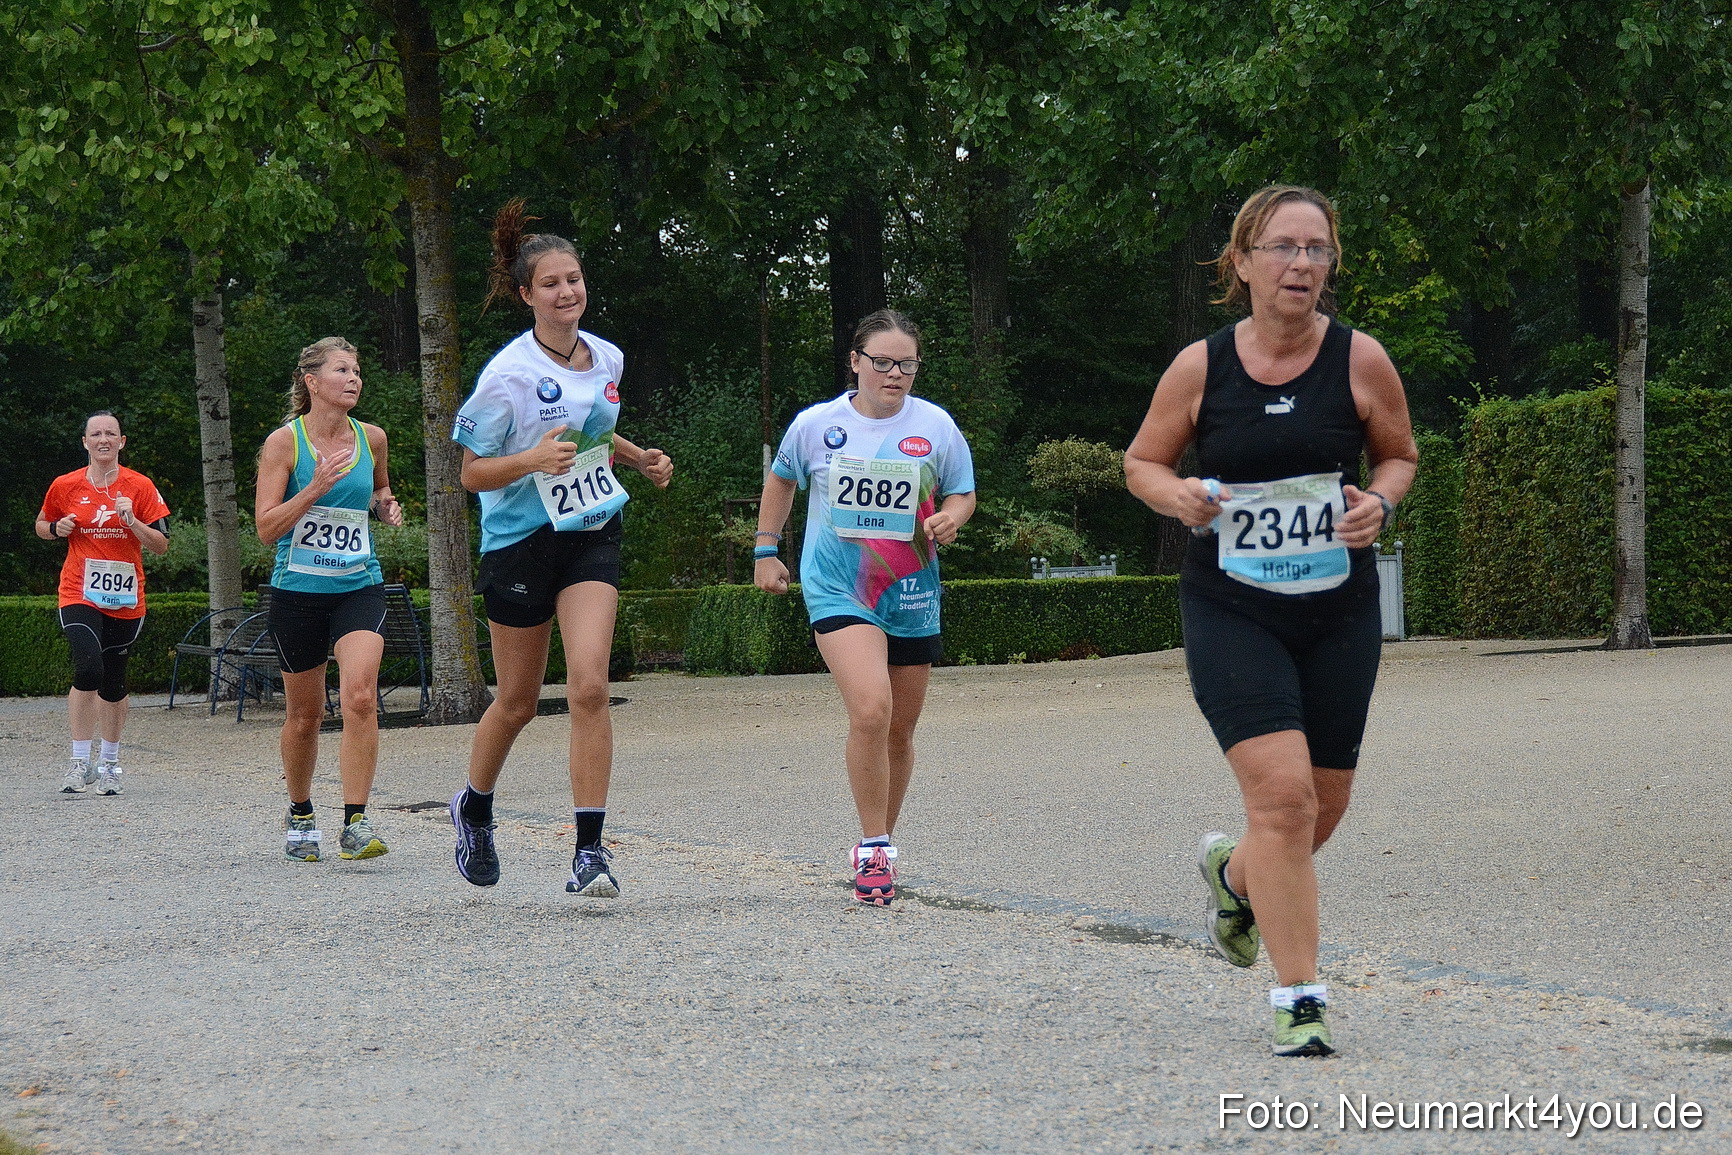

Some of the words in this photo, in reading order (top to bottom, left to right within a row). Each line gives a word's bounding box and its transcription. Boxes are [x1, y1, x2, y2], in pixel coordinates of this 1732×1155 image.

[539, 406, 568, 416] PARTL
[541, 413, 569, 422] Neumarkt
[903, 441, 929, 452] Hervis
[870, 461, 913, 473] BOCK
[551, 466, 613, 515] 2116
[837, 476, 912, 510] 2682
[583, 510, 606, 527] Rosa
[857, 515, 885, 527] Lena
[1232, 502, 1335, 550] 2344
[301, 521, 362, 552] 2396
[313, 554, 346, 567] Gisela
[1262, 562, 1311, 580] Helga
[90, 571, 134, 592] 2694
[900, 578, 920, 592] 17.
[101, 595, 121, 605] Karin
[899, 600, 930, 610] Stadtlauf
